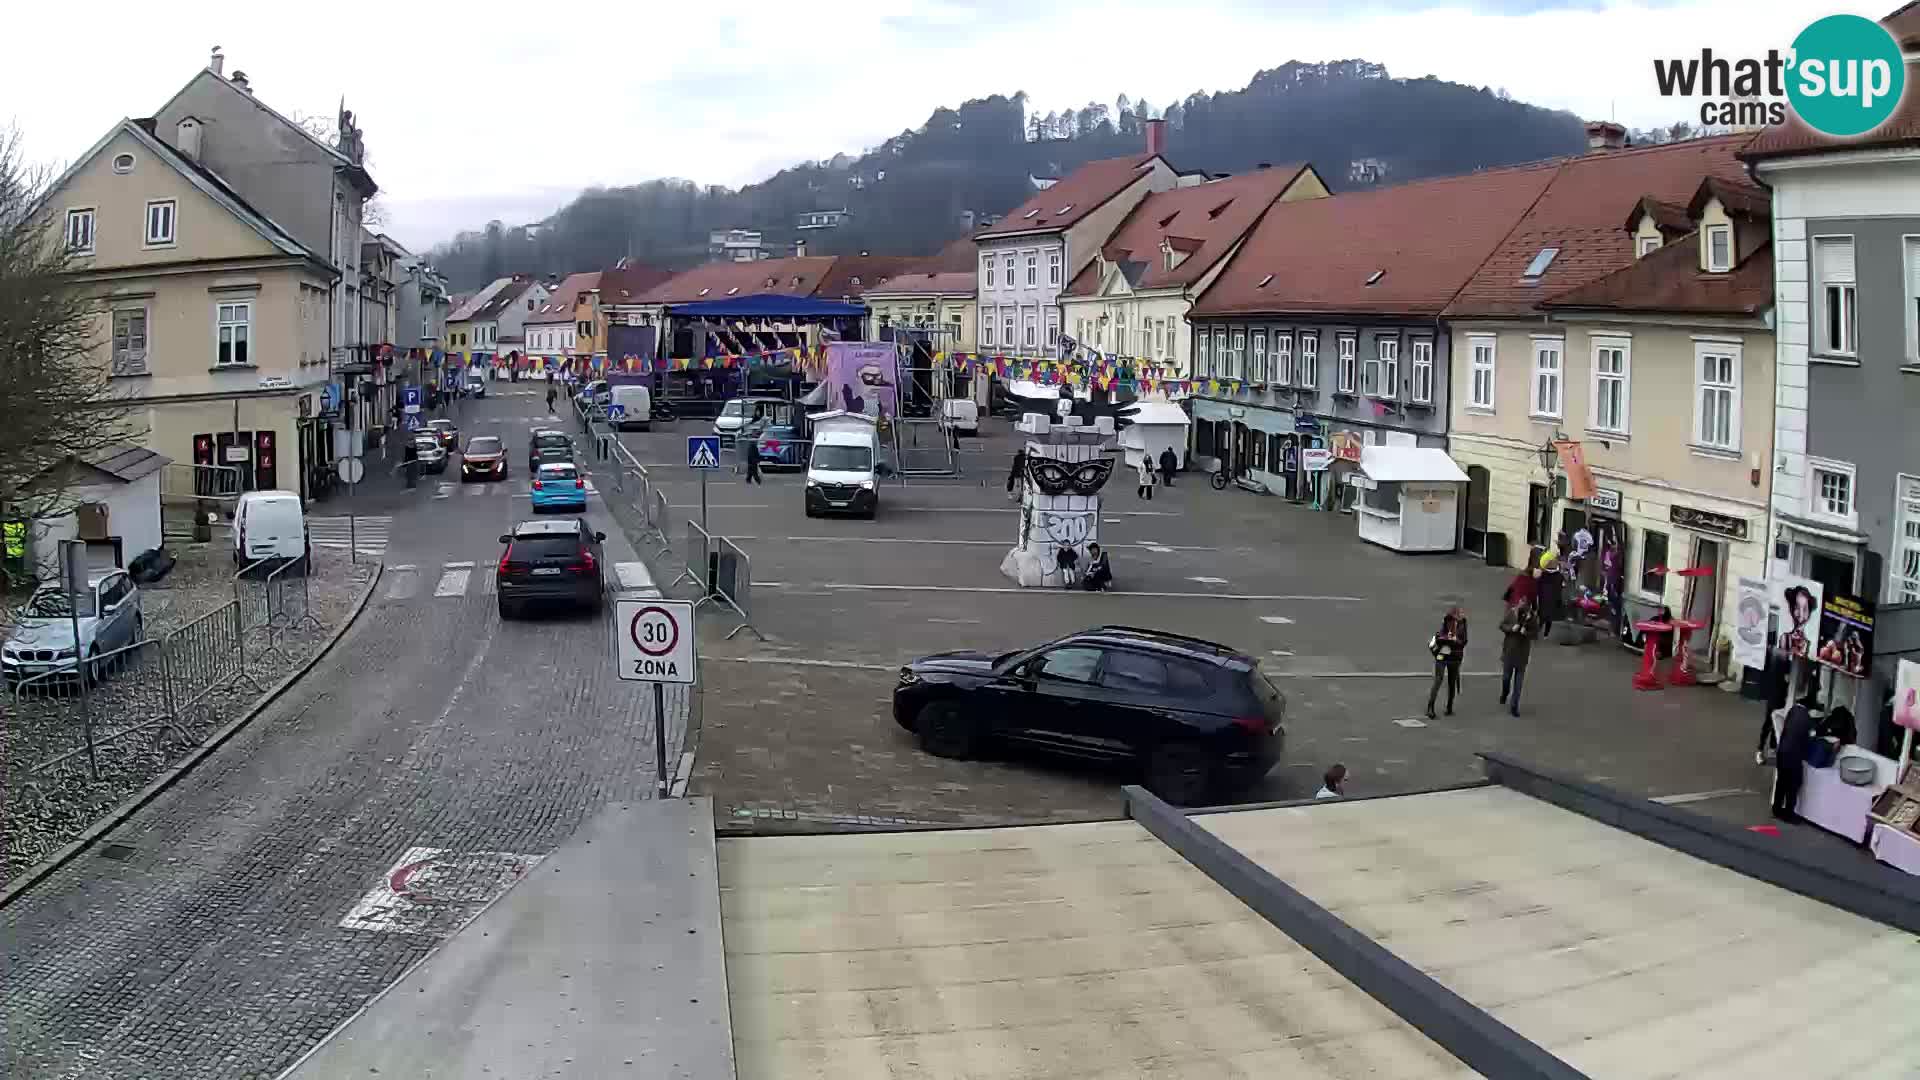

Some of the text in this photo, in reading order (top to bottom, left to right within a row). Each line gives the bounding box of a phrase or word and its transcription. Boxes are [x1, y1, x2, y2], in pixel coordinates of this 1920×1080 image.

[408, 391, 416, 403] P
[1048, 517, 1087, 542] 200
[643, 622, 667, 643] 30
[634, 660, 678, 676] ZONA
